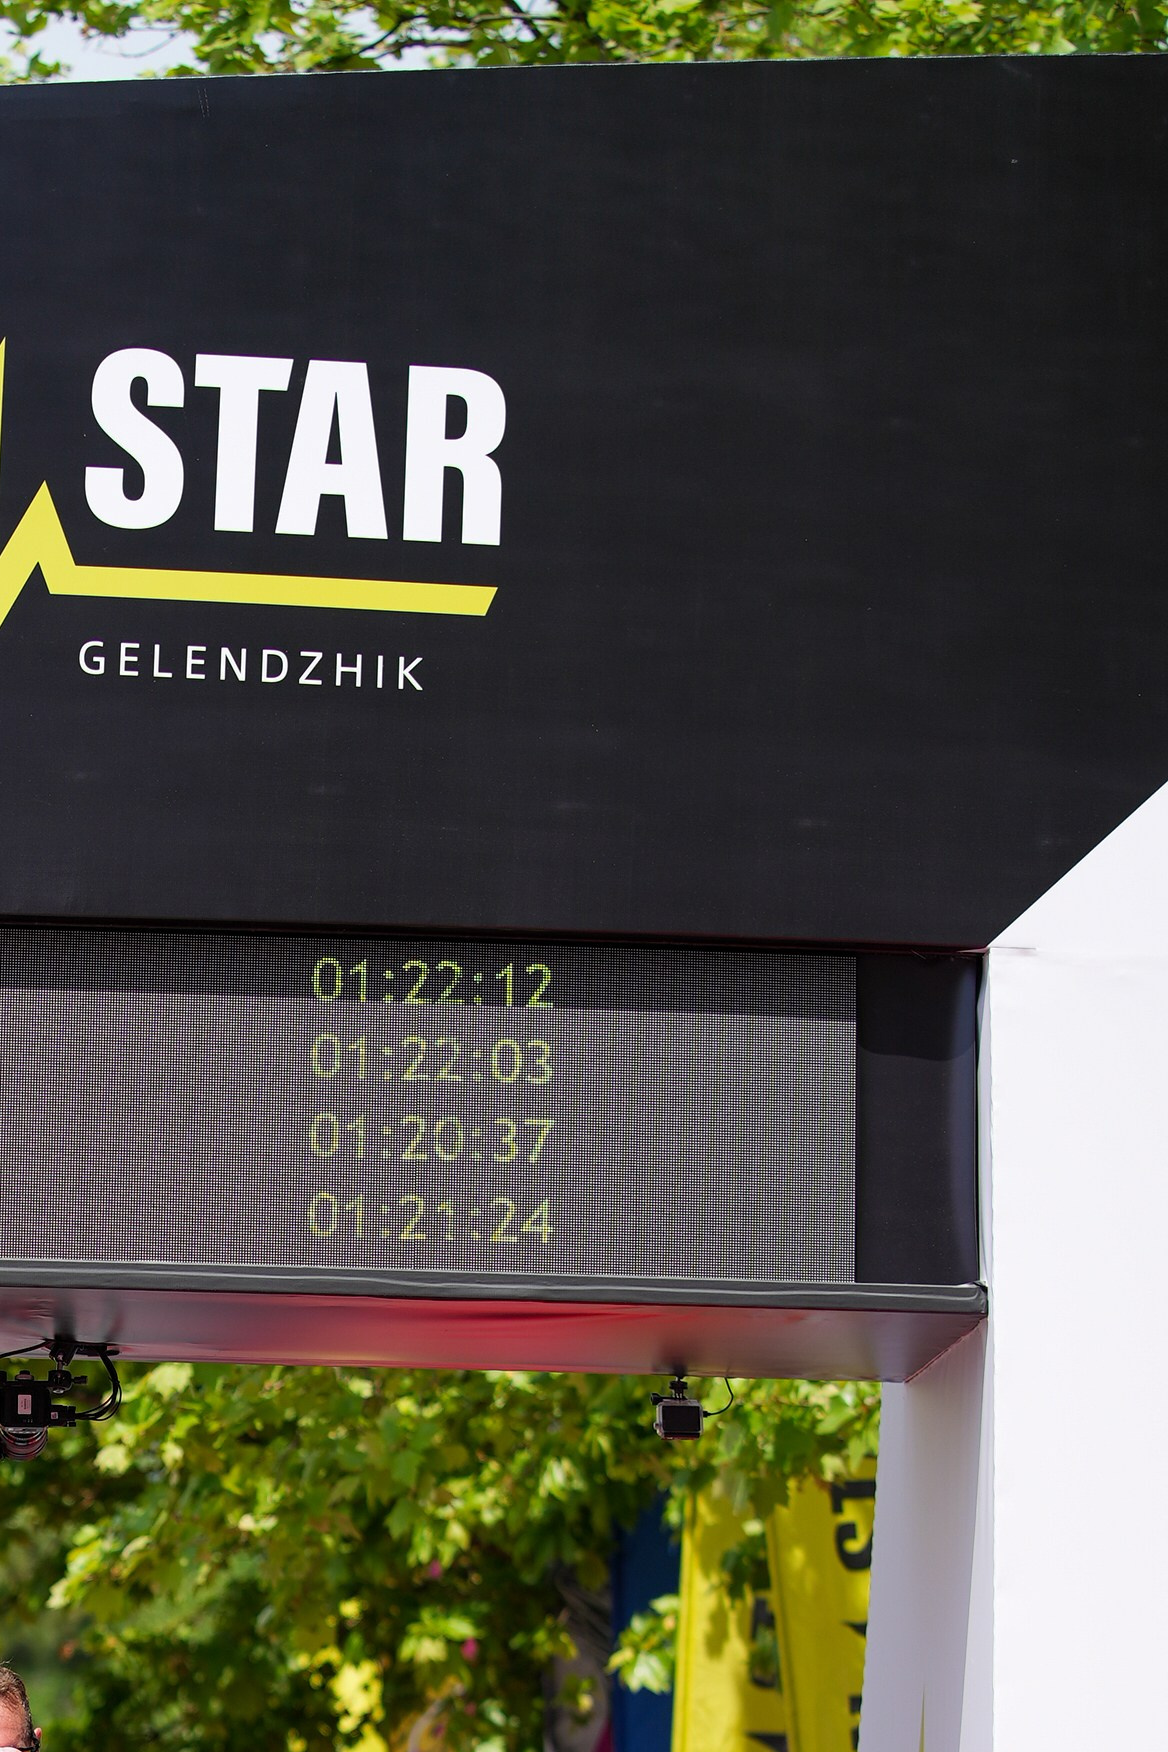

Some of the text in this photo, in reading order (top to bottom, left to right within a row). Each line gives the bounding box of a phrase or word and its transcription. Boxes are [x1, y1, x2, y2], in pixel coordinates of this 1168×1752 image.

[84, 346, 508, 547] STAR
[78, 639, 426, 692] GELENDZHIK
[311, 957, 555, 1009] 01:22:12
[310, 1032, 555, 1085] 01:22:03
[309, 1112, 556, 1164] 01:20:37
[307, 1191, 555, 1244] 01:21:24
